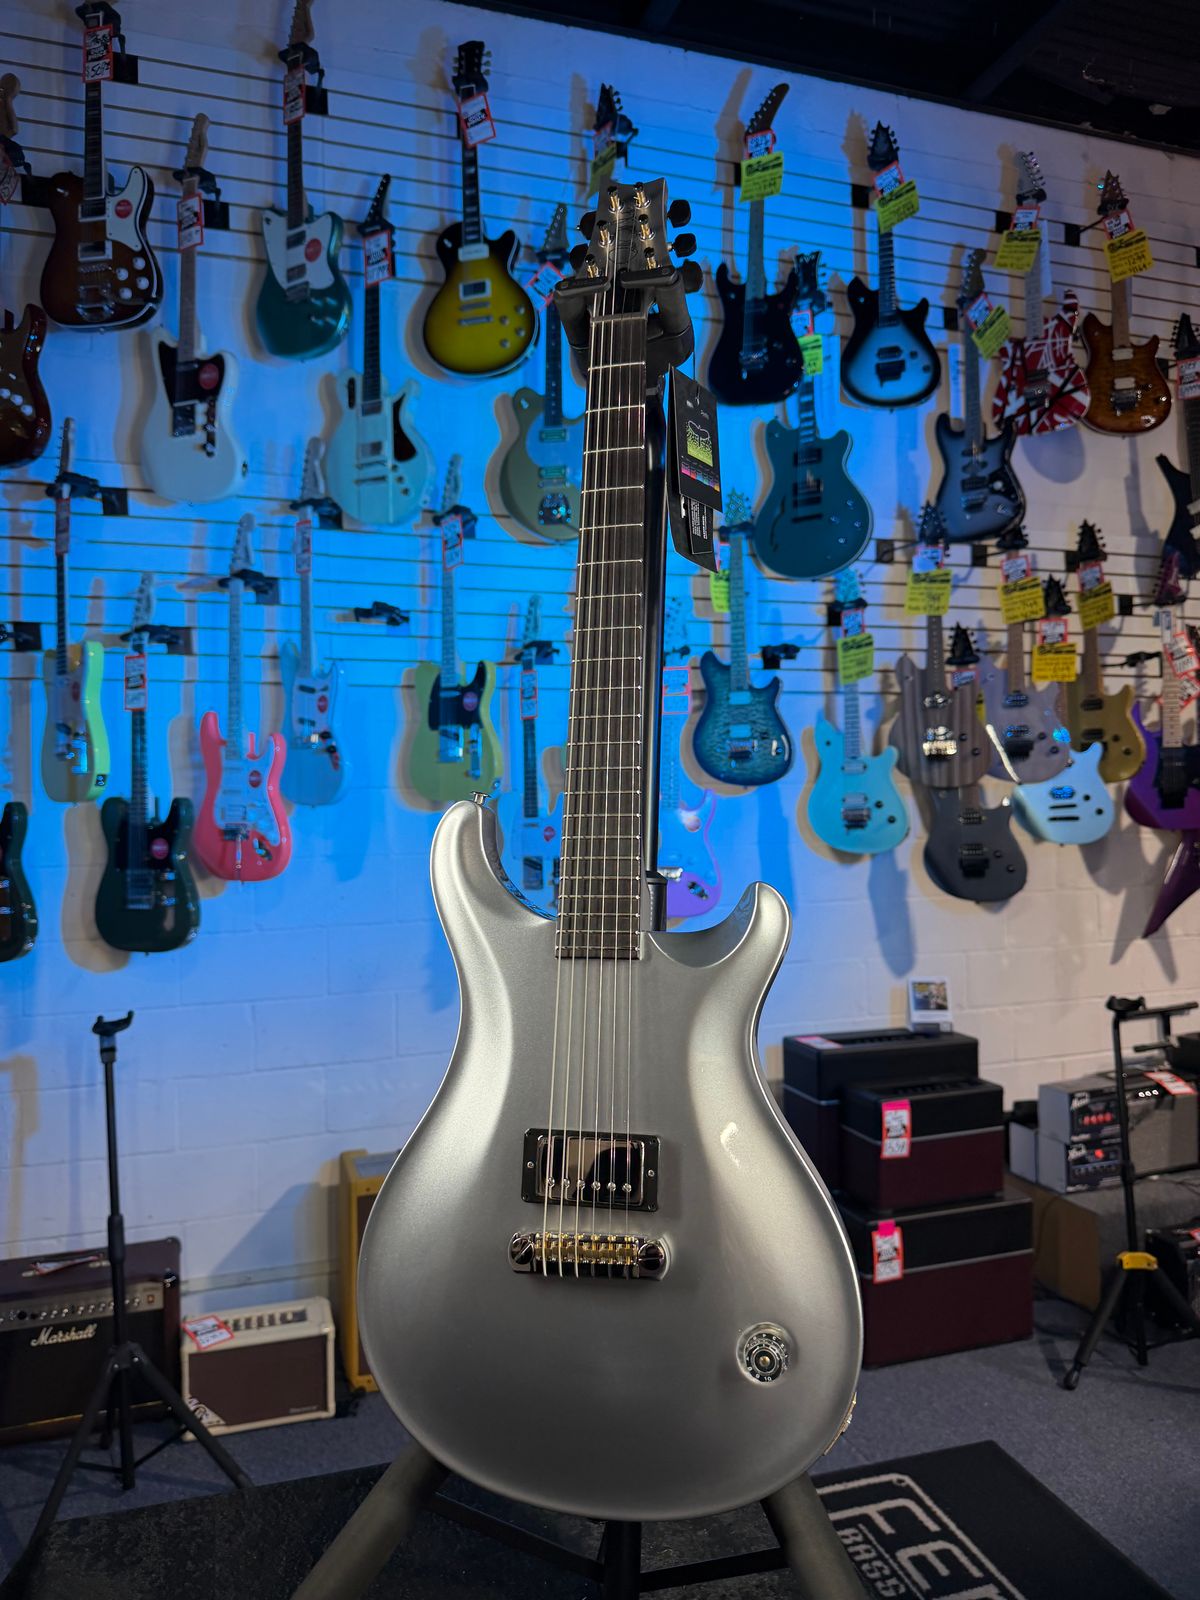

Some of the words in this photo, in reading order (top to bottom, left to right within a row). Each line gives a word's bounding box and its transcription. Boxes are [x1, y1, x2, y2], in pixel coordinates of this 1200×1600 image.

[30, 1323, 98, 1347] Marshall
[828, 1498, 1009, 1600] FE
[837, 1527, 906, 1598] BASS
